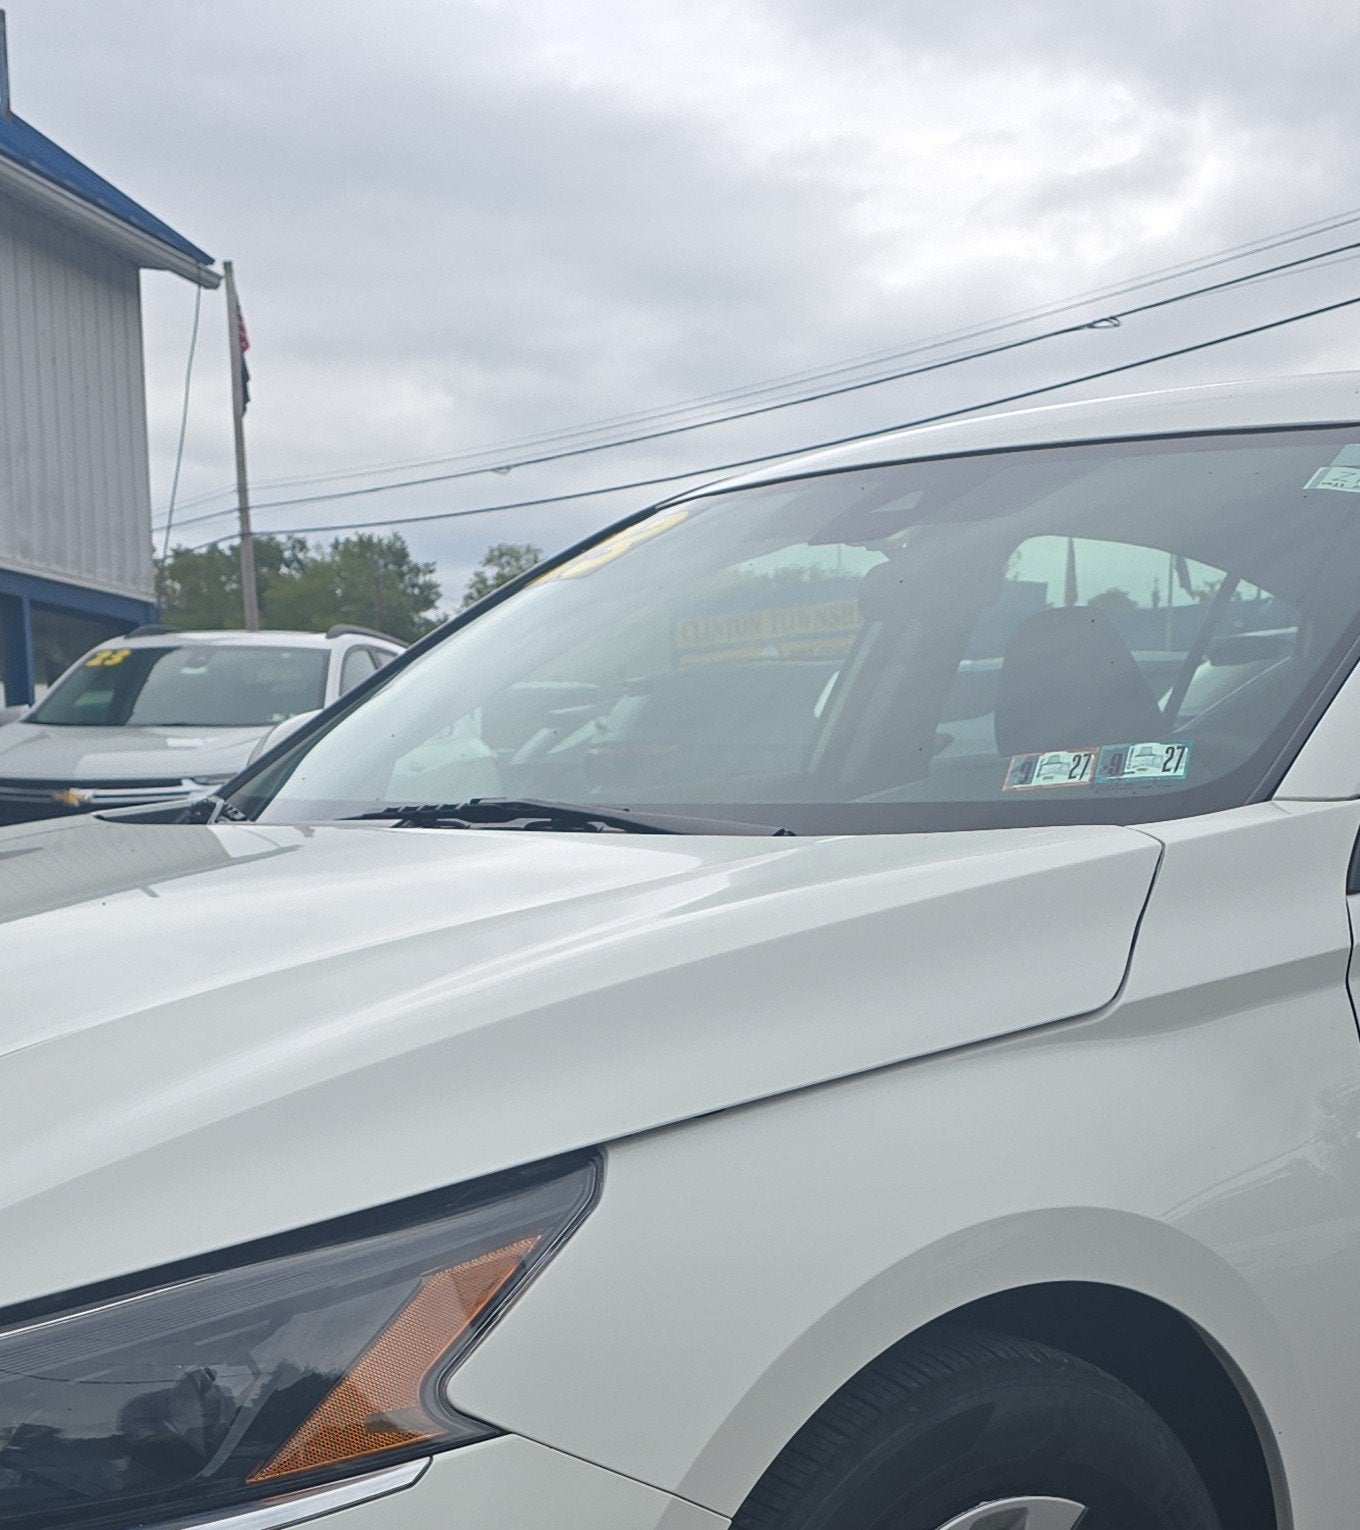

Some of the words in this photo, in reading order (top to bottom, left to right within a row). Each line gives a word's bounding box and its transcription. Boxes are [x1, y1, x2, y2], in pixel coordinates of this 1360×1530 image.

[770, 603, 857, 633] TOWNSH
[1067, 753, 1092, 780] 27
[1161, 745, 1185, 774] 27
